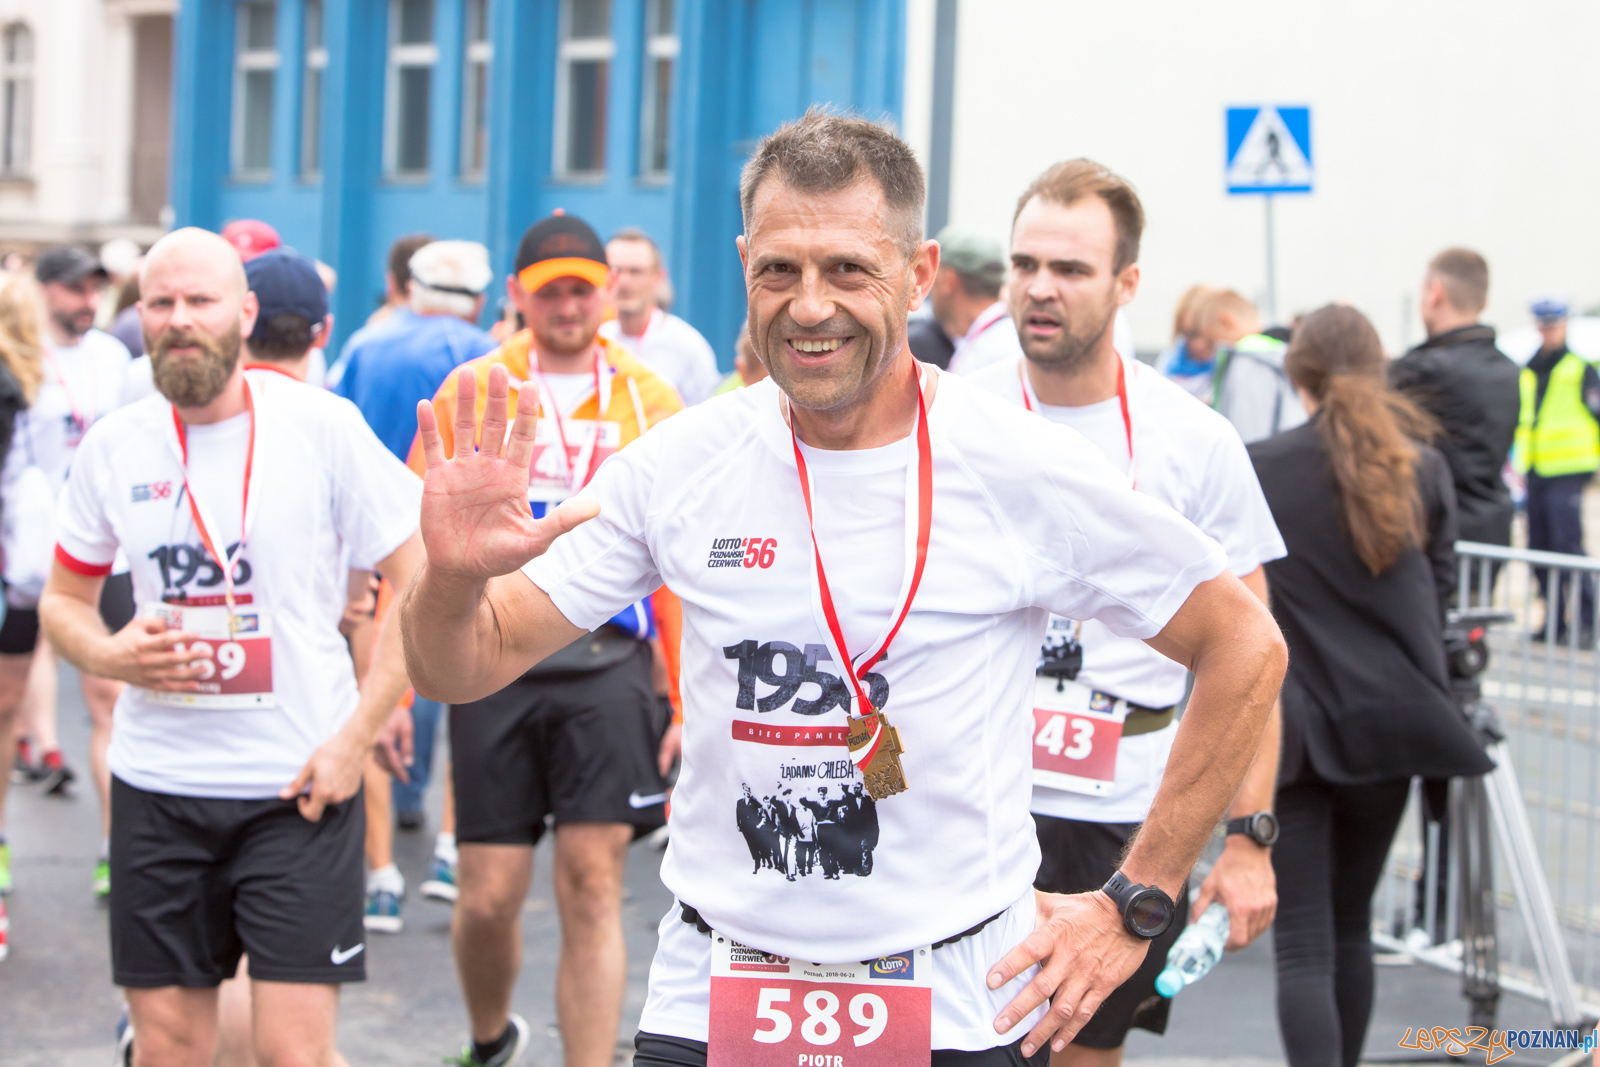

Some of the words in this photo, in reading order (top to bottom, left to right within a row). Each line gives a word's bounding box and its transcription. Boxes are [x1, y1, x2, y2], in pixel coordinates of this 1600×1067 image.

[712, 538, 742, 550] LOTTO
[709, 549, 745, 558] POZNAŃSKI
[707, 559, 743, 568] CZERWIEC
[748, 728, 781, 739] BIEG
[794, 732, 853, 741] PAMIĘ
[847, 730, 871, 747] POZNAŃ
[1032, 714, 1095, 760] 43
[818, 760, 854, 779] CHLEBA
[730, 954, 764, 963] CZERWIEC
[881, 959, 903, 970] LOTTO
[825, 971, 856, 979] 2018-06-24
[752, 987, 888, 1048] 589
[798, 1053, 843, 1067] PIOTR
